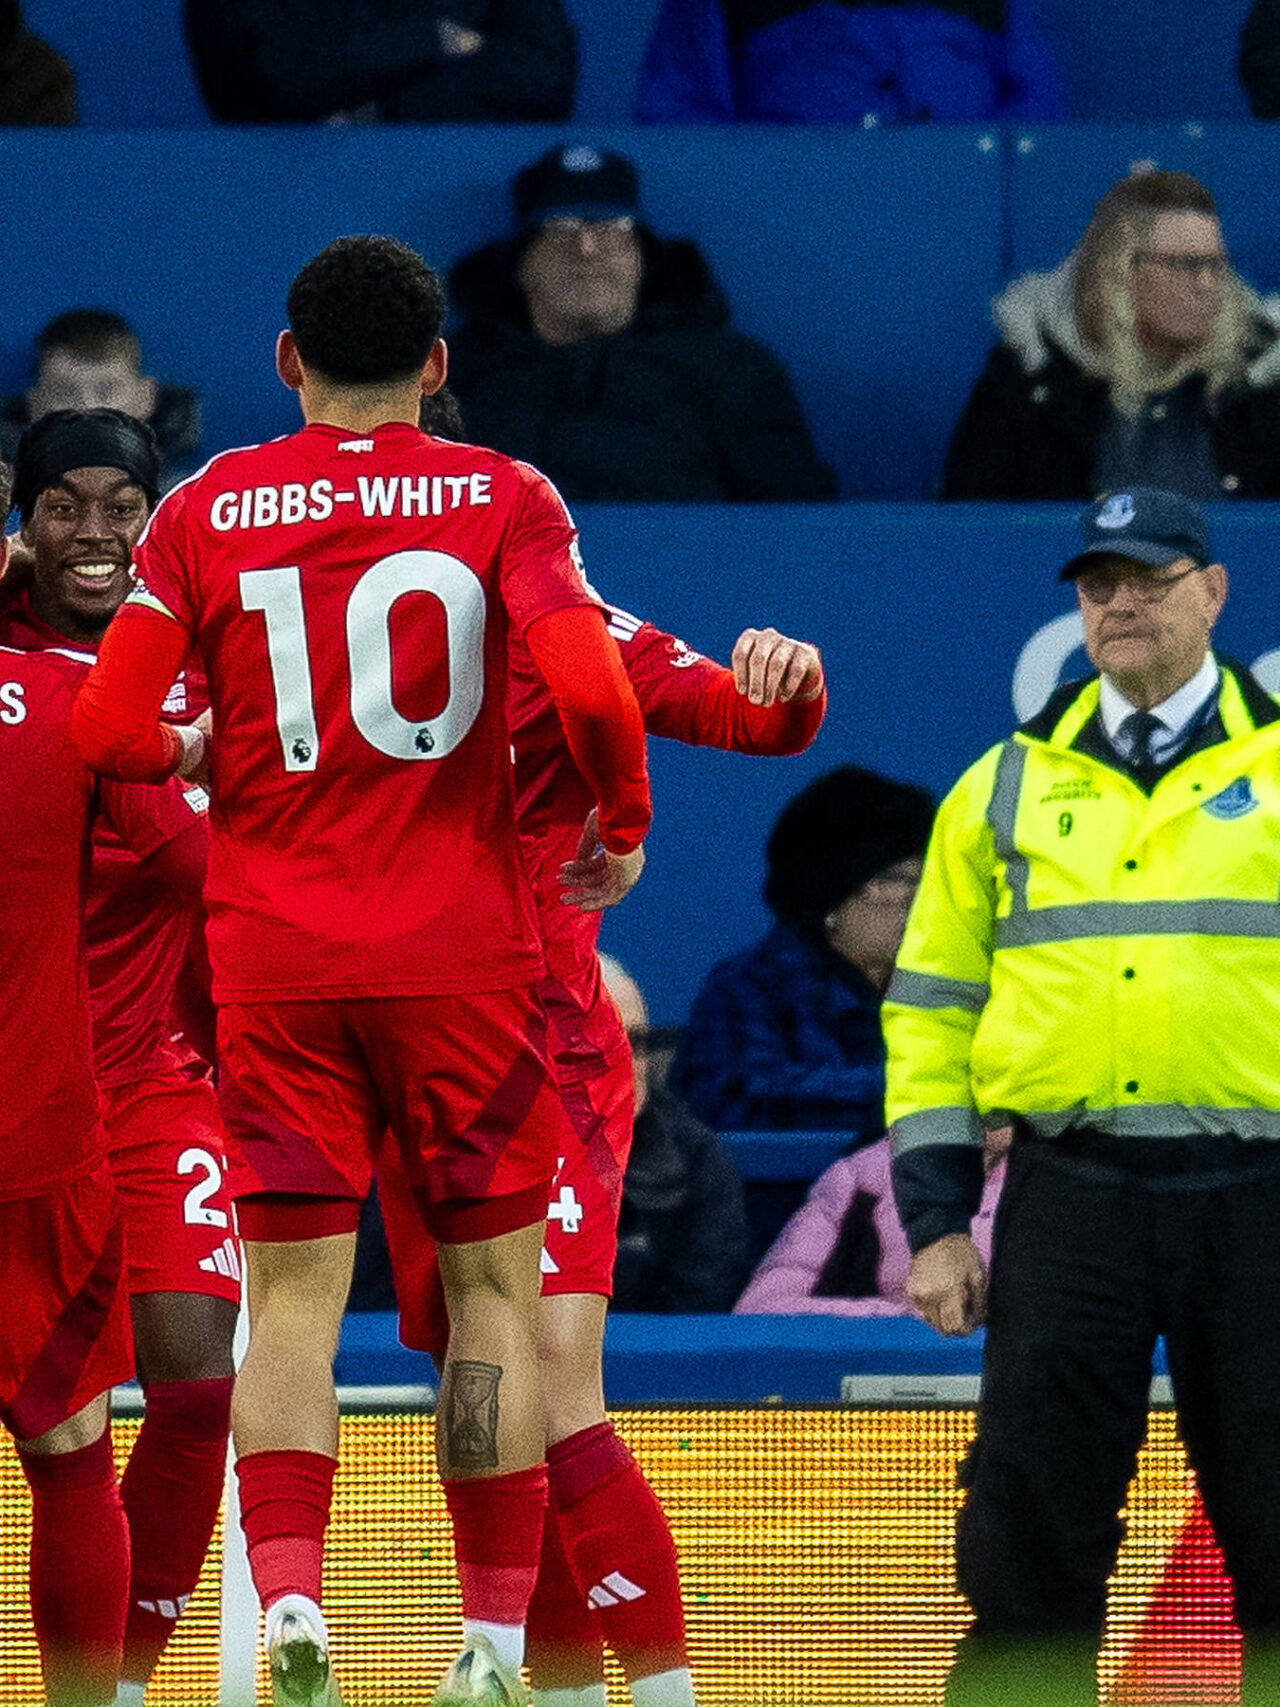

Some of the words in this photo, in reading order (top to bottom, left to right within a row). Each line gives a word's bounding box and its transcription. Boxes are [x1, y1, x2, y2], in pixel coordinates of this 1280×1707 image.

[210, 473, 491, 532] GIBBS-WHITE
[239, 550, 486, 772] 10
[1058, 811, 1073, 838] 9
